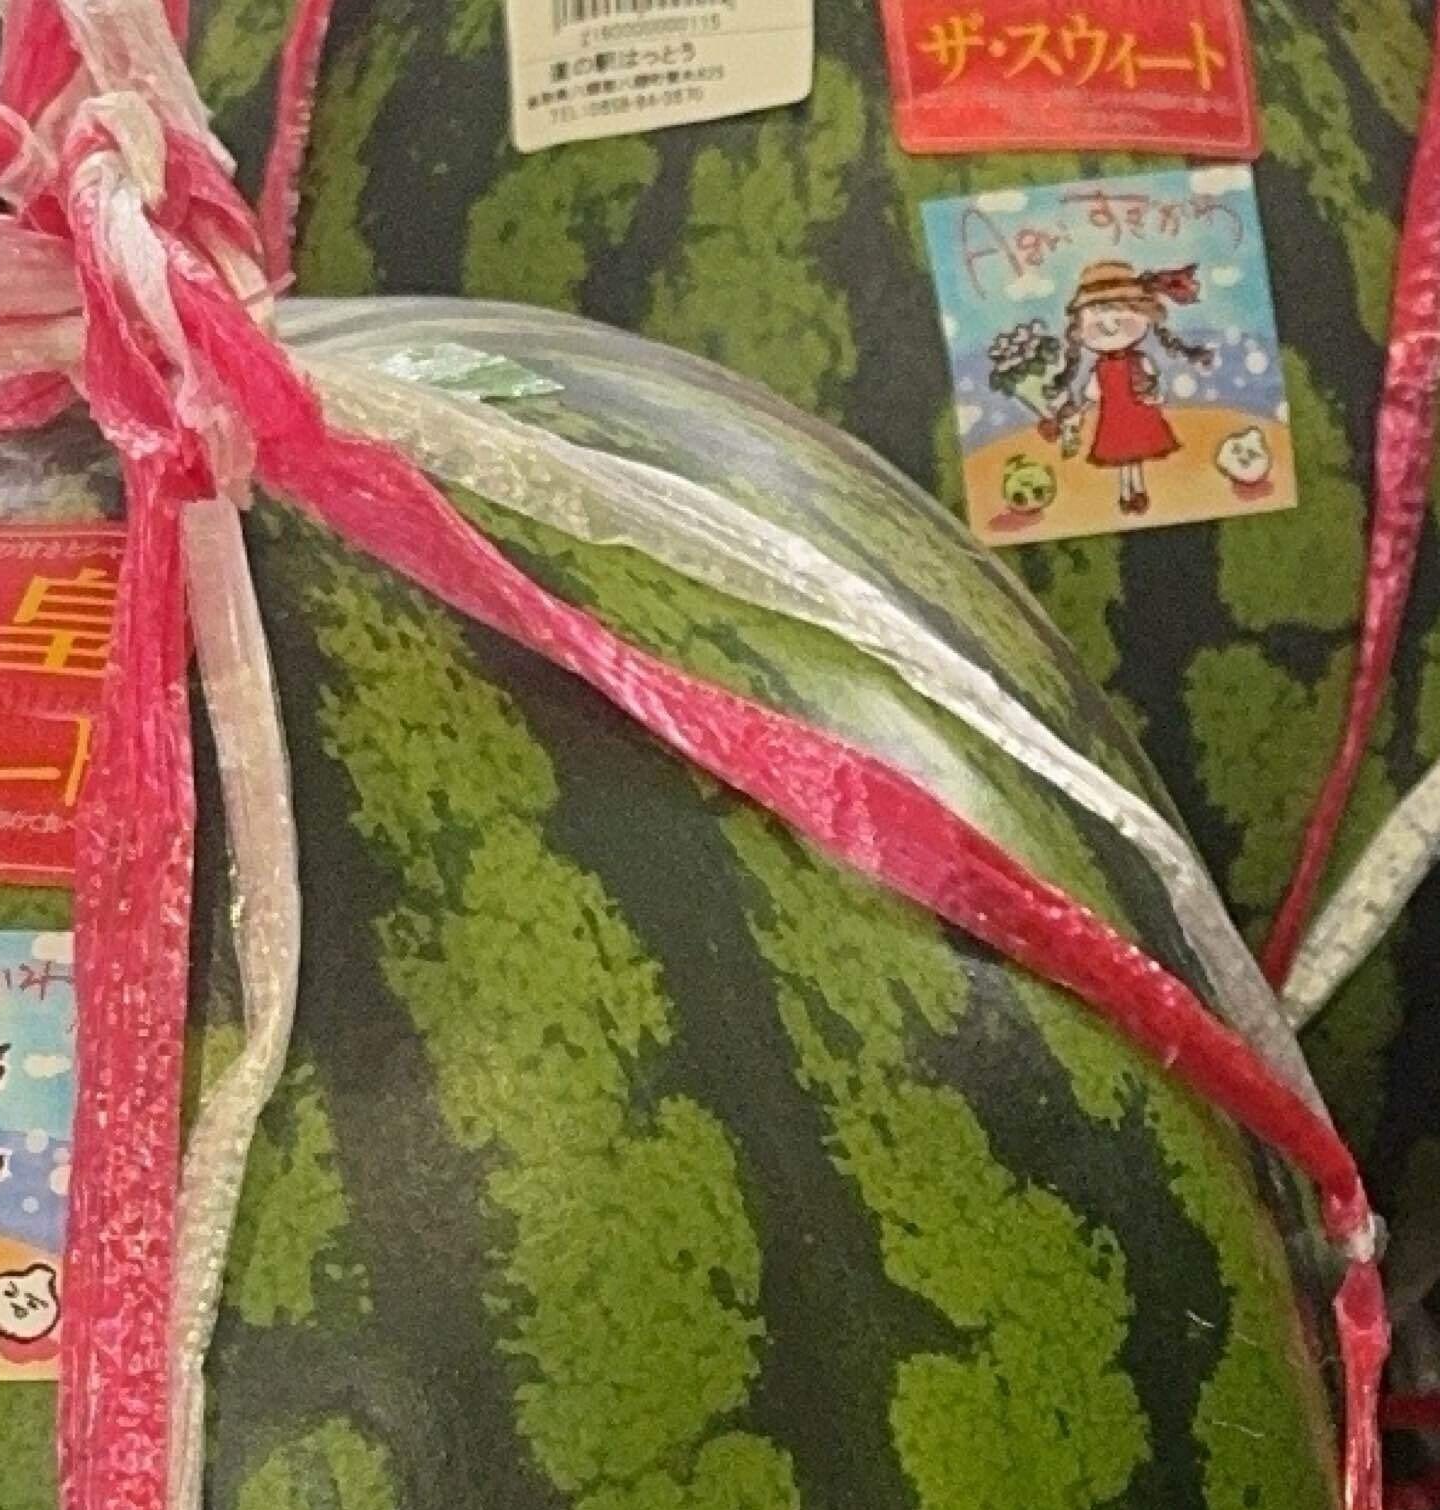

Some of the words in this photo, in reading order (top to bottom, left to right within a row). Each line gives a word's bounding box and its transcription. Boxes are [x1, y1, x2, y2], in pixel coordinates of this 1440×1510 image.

[915, 12, 1226, 92] ザ・スウィート
